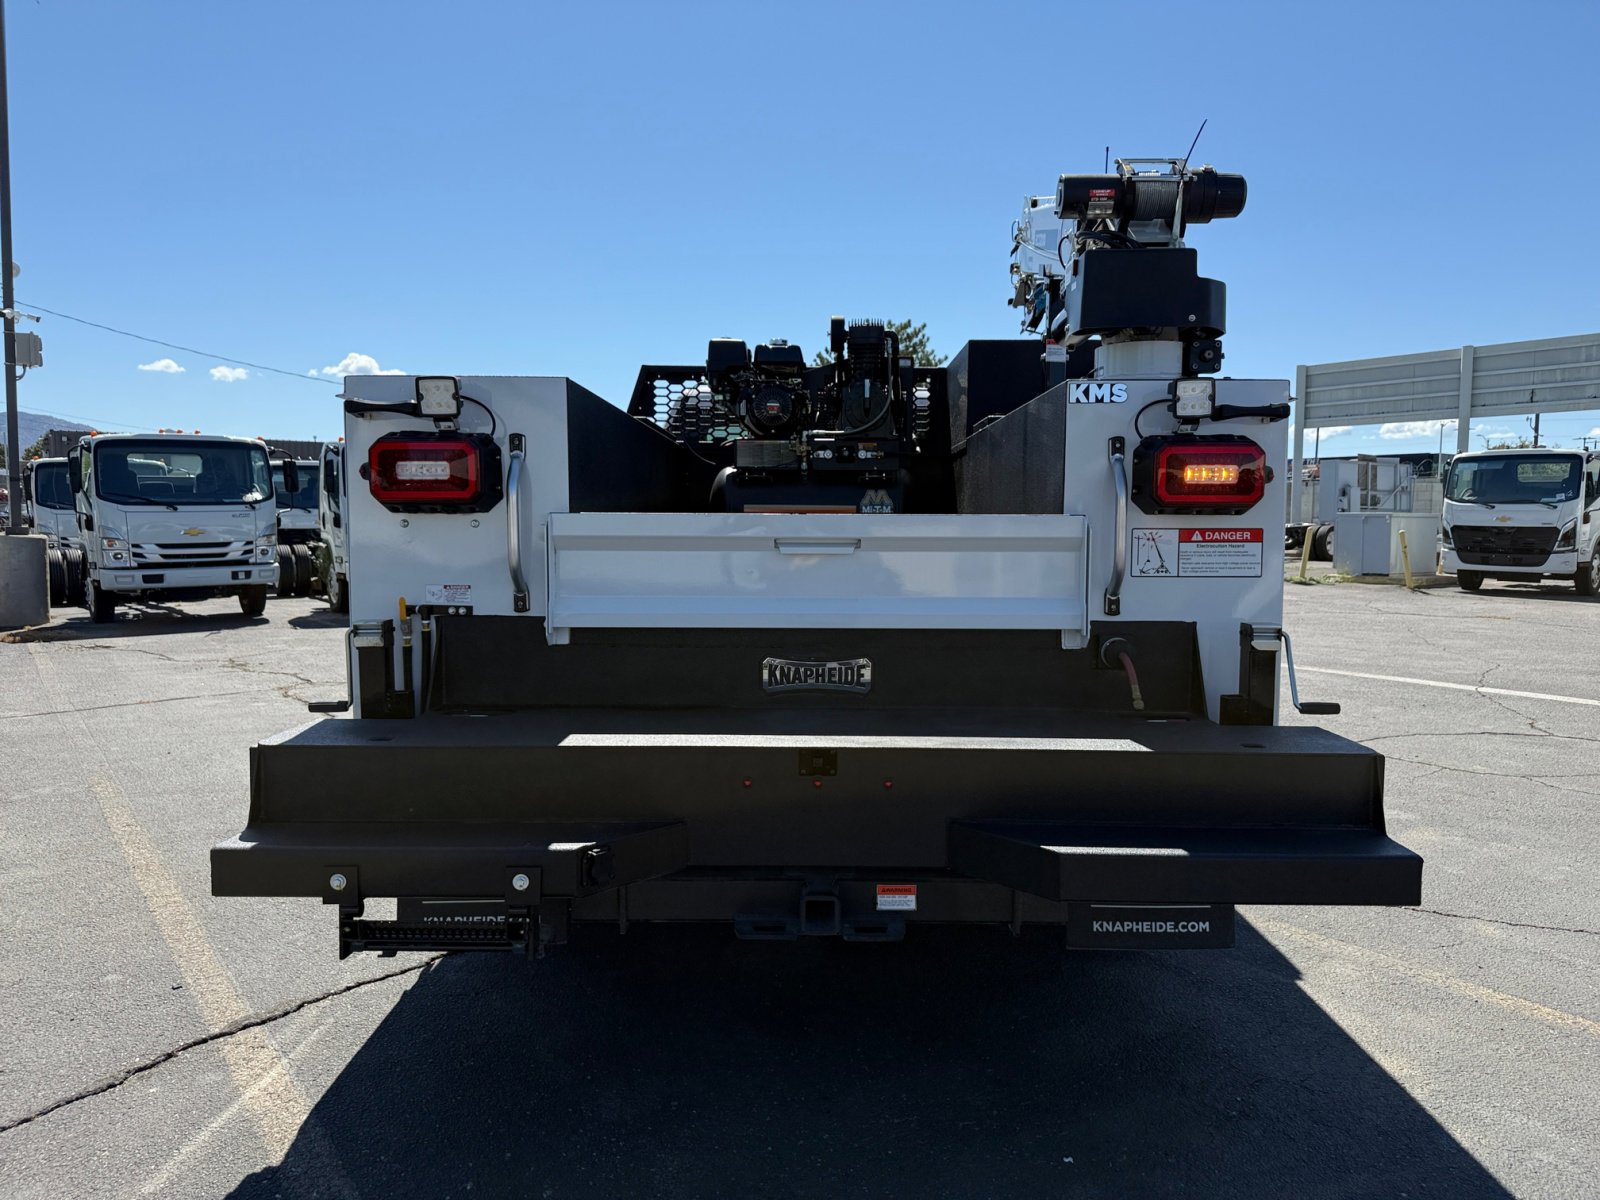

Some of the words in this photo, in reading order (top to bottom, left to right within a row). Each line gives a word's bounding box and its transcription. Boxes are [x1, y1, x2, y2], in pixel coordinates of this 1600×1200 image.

[1069, 383, 1128, 403] KMS
[1205, 531, 1251, 540] DANGER
[767, 663, 867, 688] KNAPHEIDE
[1092, 920, 1210, 933] KNAPHEIDE.COM
